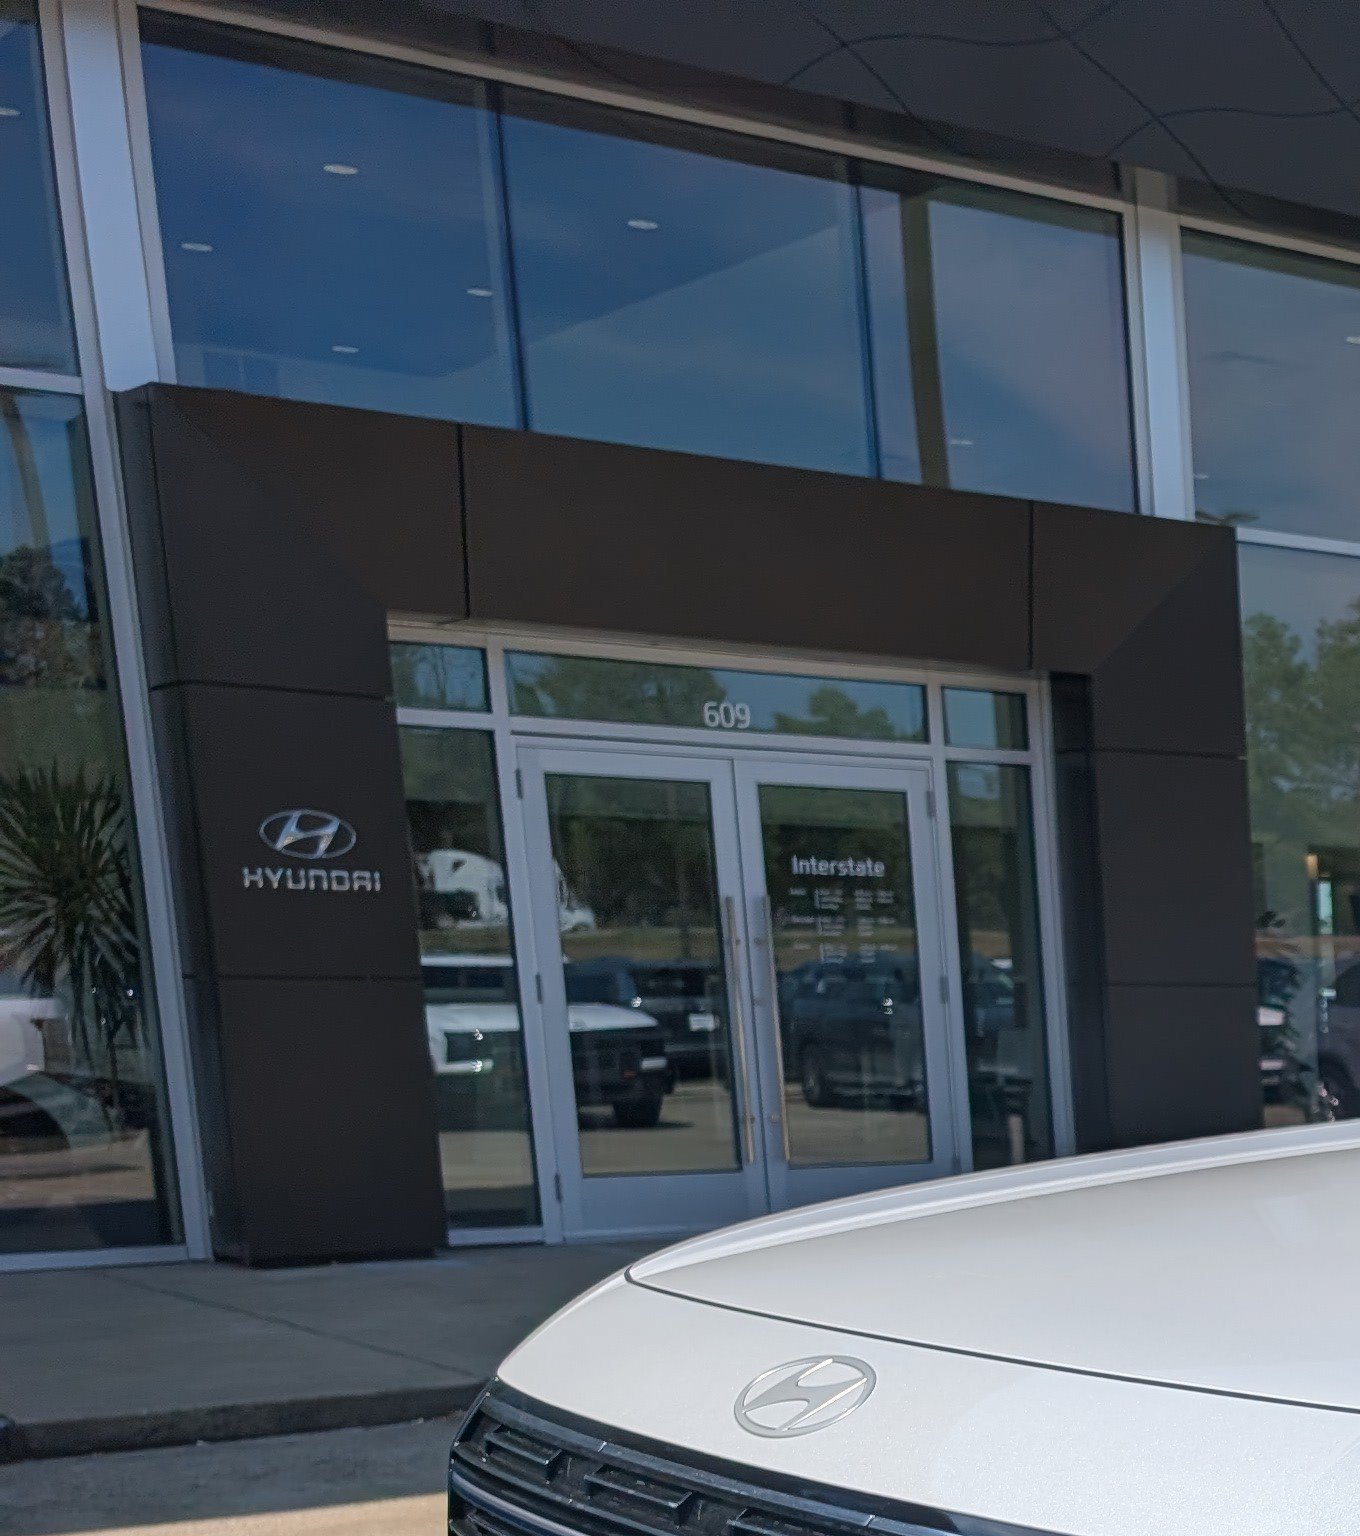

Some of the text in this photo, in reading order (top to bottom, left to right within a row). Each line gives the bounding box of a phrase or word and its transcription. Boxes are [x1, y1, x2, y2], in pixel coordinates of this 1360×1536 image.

[703, 701, 751, 728] 609
[791, 854, 885, 877] Interstate
[242, 866, 381, 892] HYUNDAI
